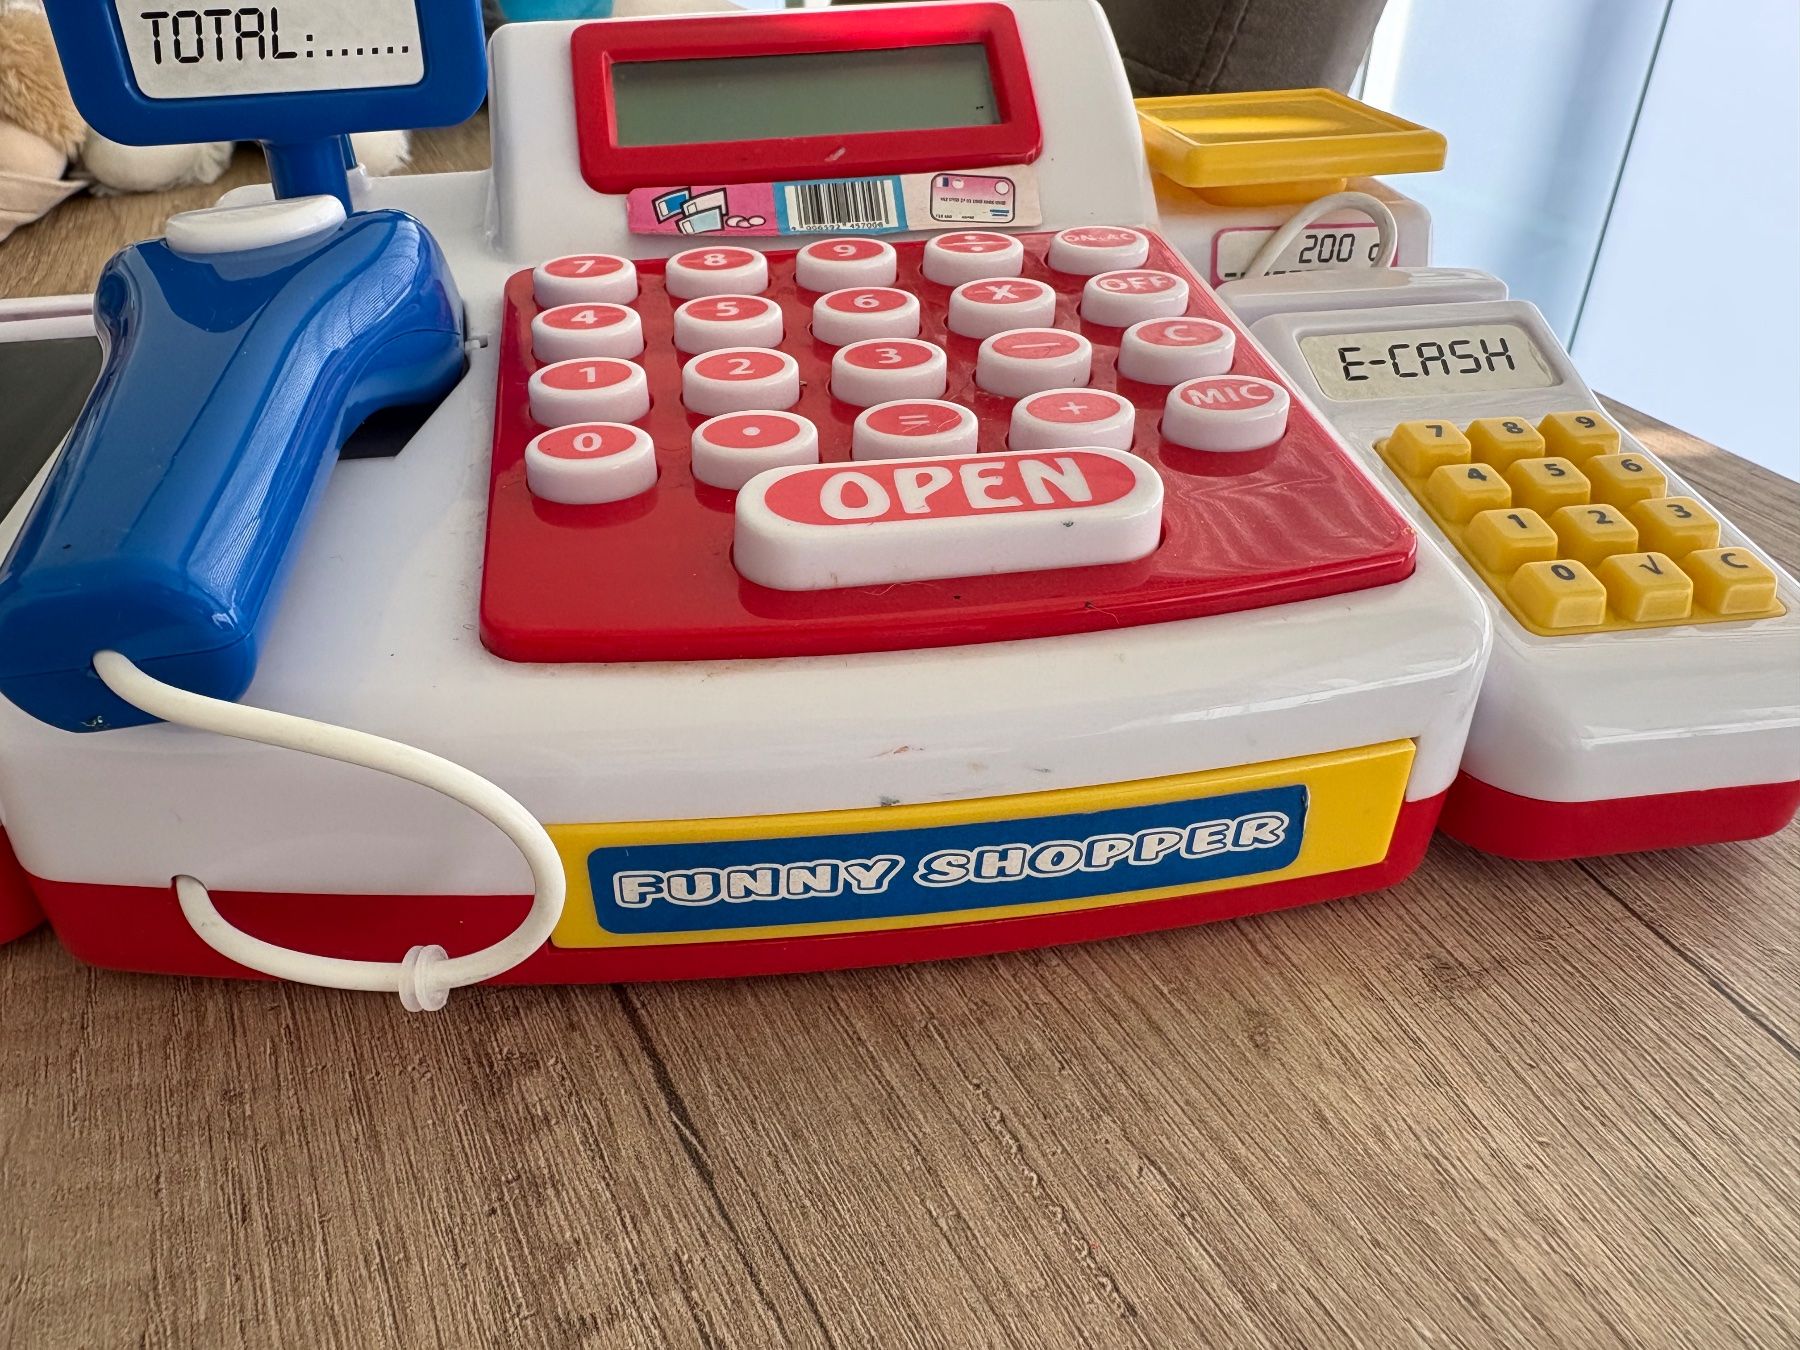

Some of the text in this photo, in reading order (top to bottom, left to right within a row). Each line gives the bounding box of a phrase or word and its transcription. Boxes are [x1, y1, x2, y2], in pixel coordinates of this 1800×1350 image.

[832, 244, 857, 257] 9
[1299, 233, 1356, 264] 200
[572, 260, 596, 274] 7
[702, 253, 728, 267] 8
[1099, 275, 1169, 292] OFF
[715, 301, 741, 317] 5
[853, 294, 881, 309] 6
[570, 309, 599, 325] 4
[1163, 324, 1198, 342] C
[874, 347, 902, 365] 3
[1338, 337, 1516, 382] E-CASH
[578, 366, 597, 383] 1
[727, 358, 756, 376] 2
[1186, 383, 1269, 406] MIC
[1501, 421, 1525, 434] 8
[1575, 416, 1596, 429] 9
[1425, 424, 1443, 438] 7
[572, 432, 603, 452] 0
[1543, 463, 1566, 477] 5
[1620, 458, 1643, 473] 6
[1467, 467, 1488, 482] 4
[819, 456, 1094, 520] OPEN
[1587, 509, 1615, 525] 2
[1666, 503, 1693, 519] 3
[1506, 513, 1528, 529] 1
[1720, 552, 1749, 569] C
[1550, 564, 1576, 581] 0
[612, 810, 1290, 909] FUNNY SHOPPER
